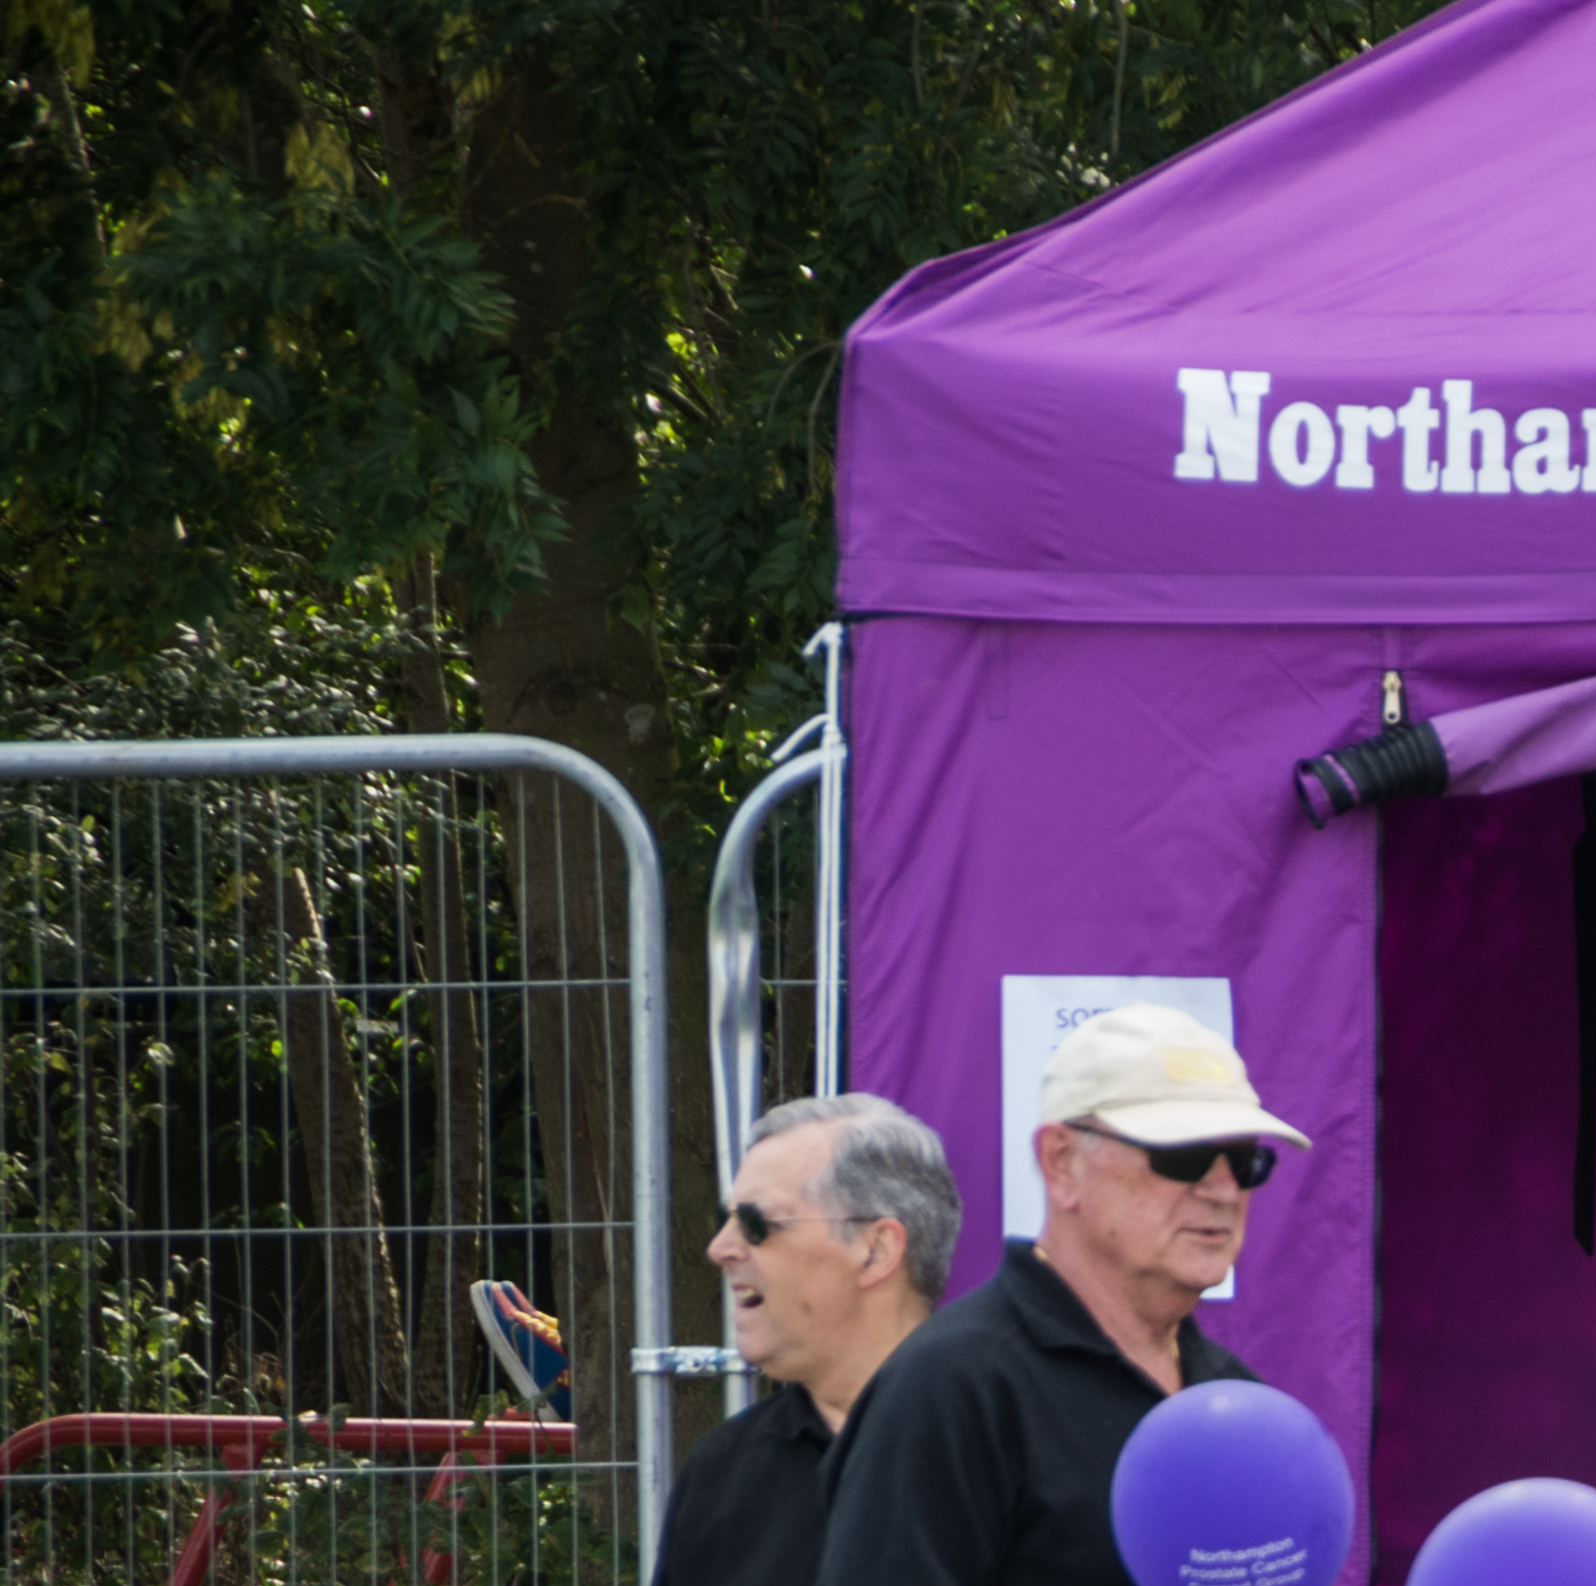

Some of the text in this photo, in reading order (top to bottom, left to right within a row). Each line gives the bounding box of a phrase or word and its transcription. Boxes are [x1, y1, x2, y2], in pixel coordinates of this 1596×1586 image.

[1056, 1008, 1114, 1029] SO
[1190, 1537, 1295, 1562] Northampton
[1179, 1548, 1307, 1579] Prostate Cancer
